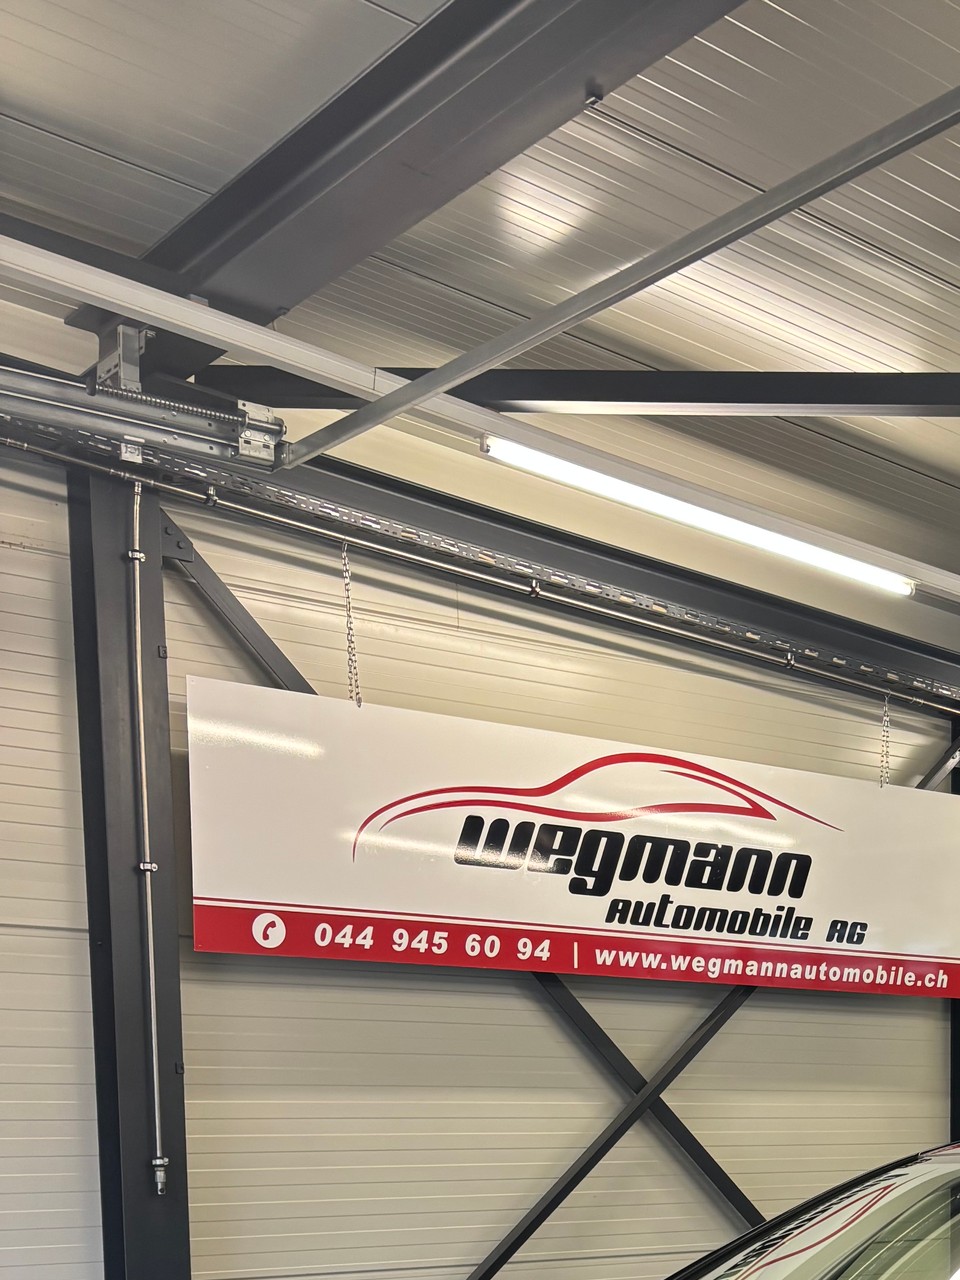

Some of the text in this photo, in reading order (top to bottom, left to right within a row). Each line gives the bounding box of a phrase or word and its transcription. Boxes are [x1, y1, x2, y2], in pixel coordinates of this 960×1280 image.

[453, 814, 813, 899] wegmann
[314, 922, 551, 961] 044 945 60 94
[825, 919, 869, 945] AG
[595, 947, 950, 989] www.wegmannautomobile.ch
